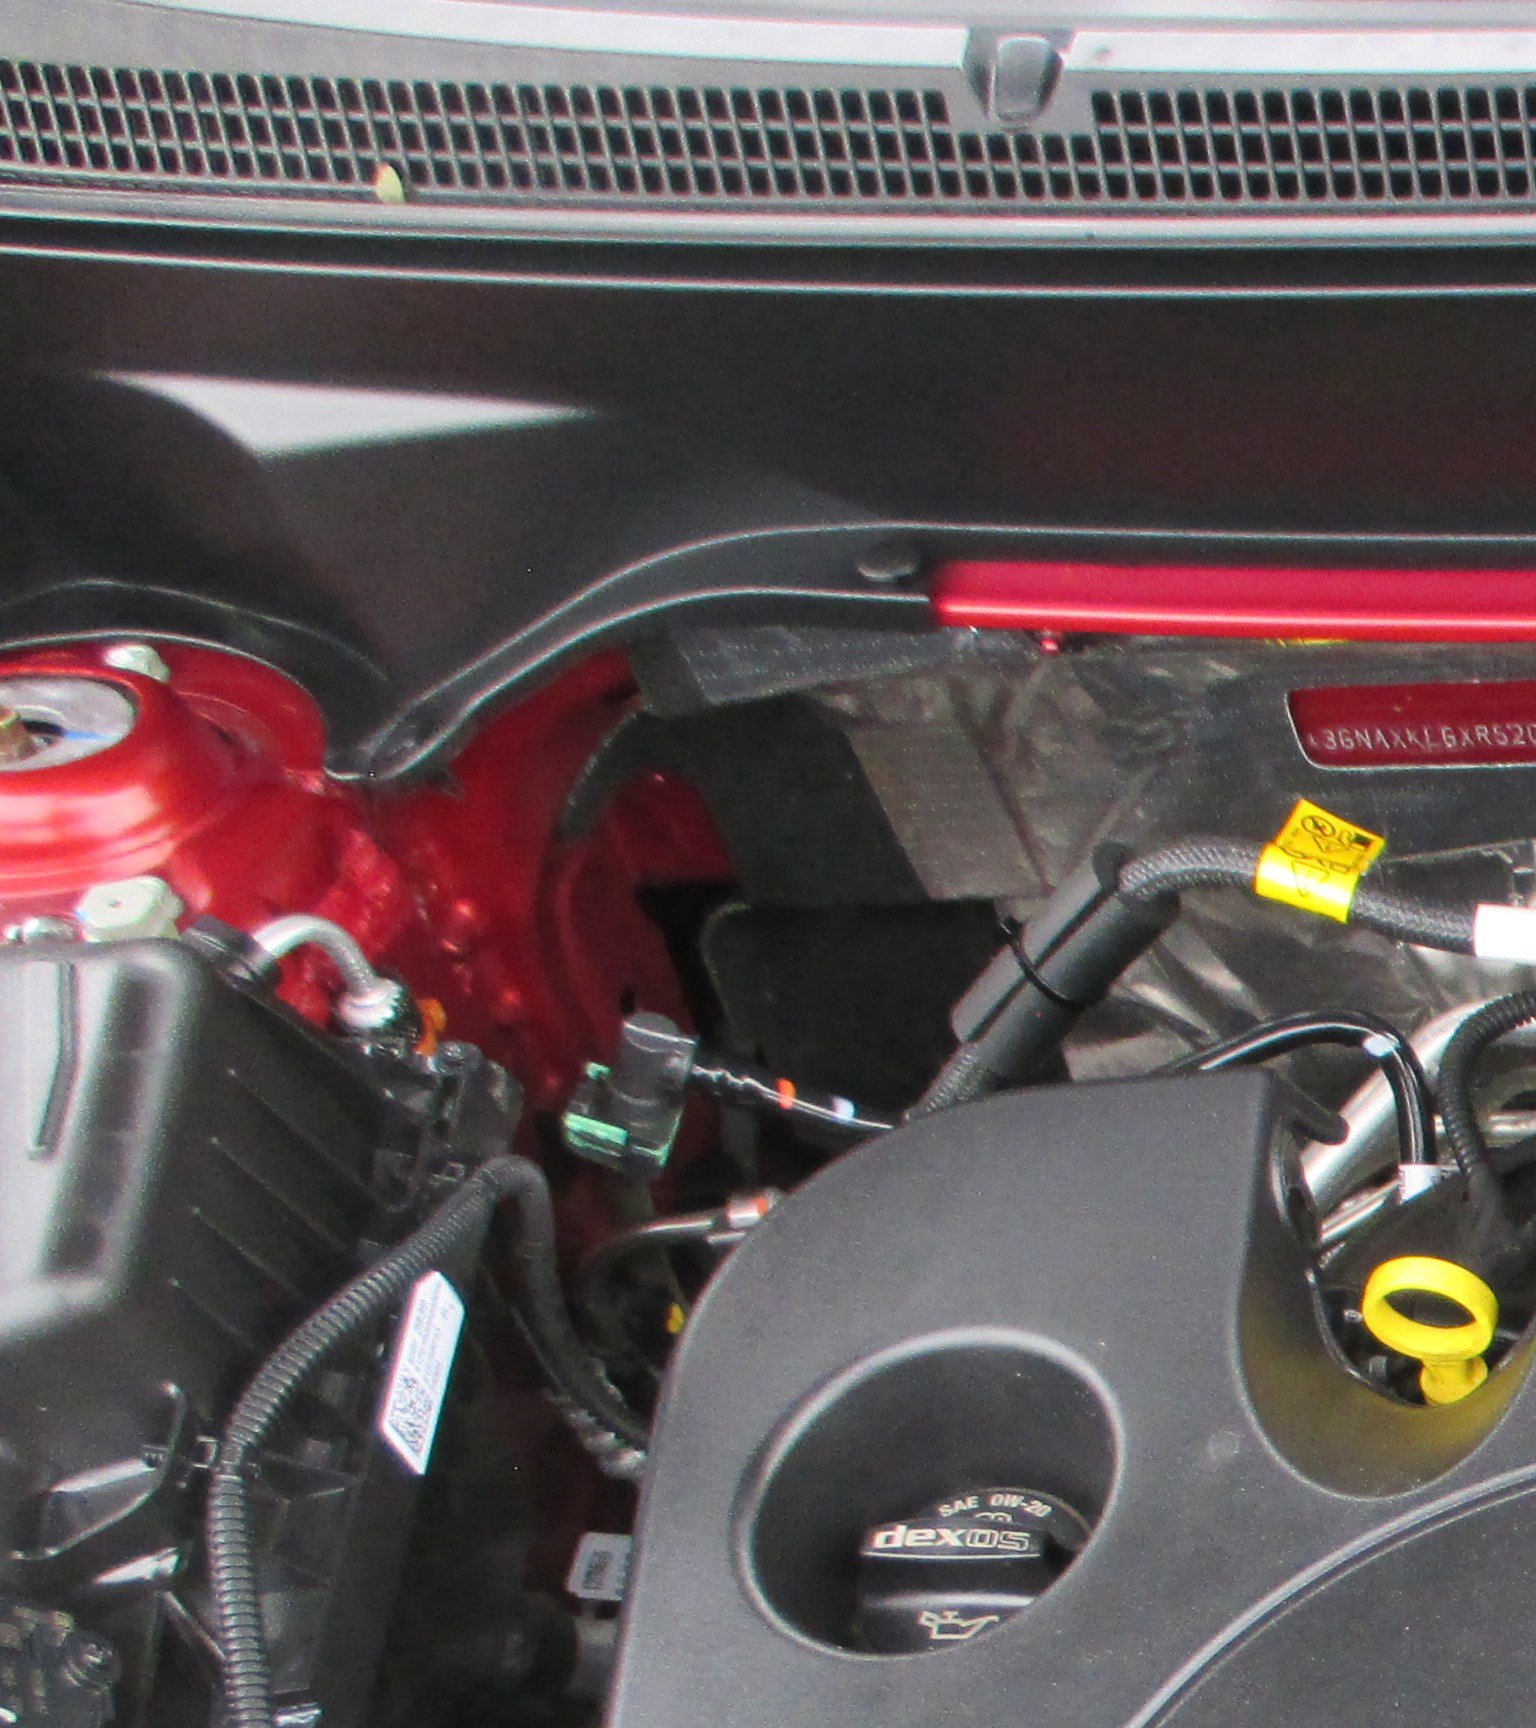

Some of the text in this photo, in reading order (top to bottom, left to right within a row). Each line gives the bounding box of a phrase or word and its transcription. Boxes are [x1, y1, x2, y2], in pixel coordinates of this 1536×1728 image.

[937, 1493, 1053, 1518] SAE 0W-20
[871, 1523, 1032, 1552] dexos
